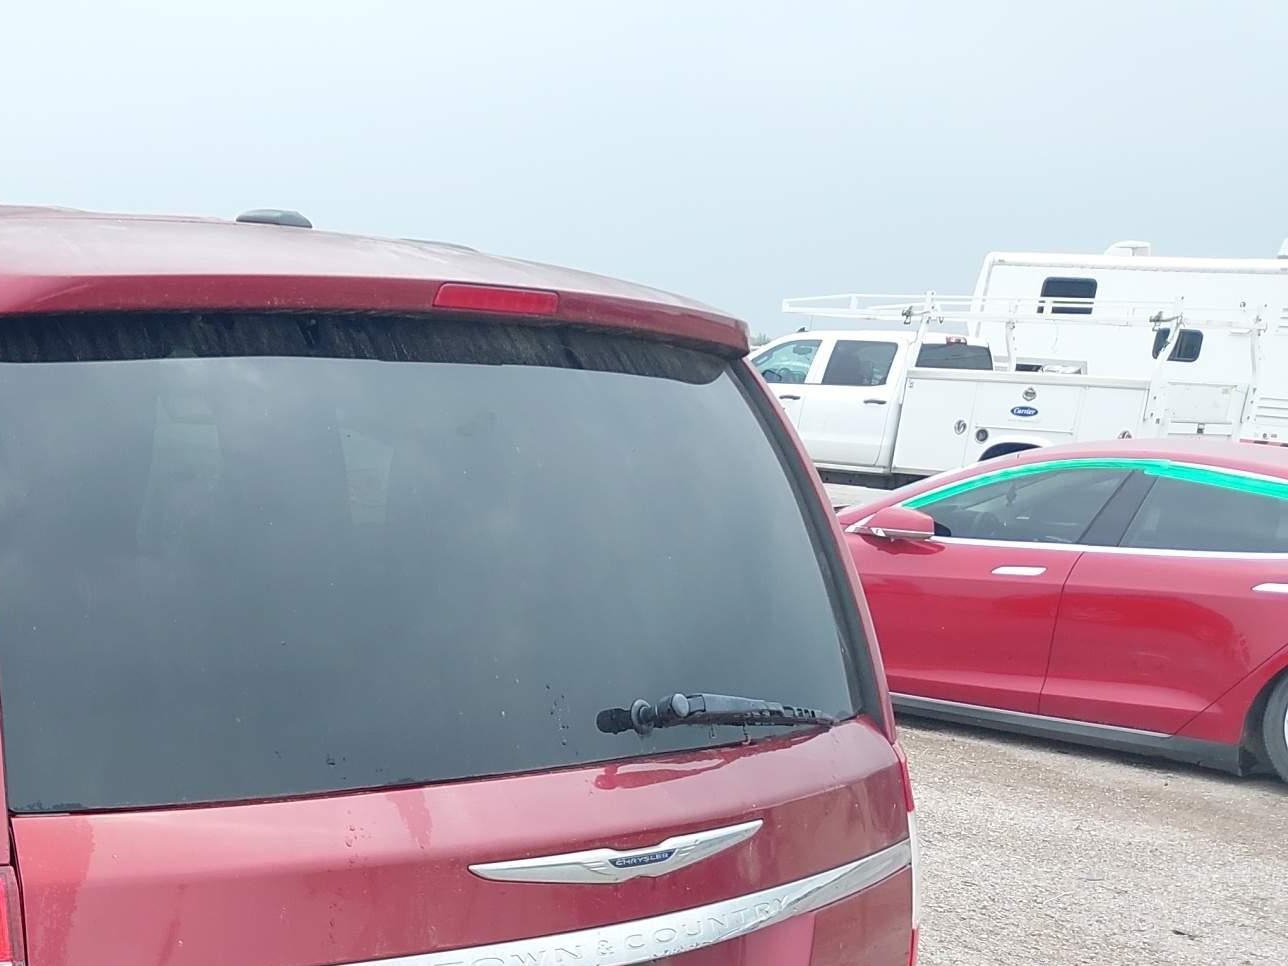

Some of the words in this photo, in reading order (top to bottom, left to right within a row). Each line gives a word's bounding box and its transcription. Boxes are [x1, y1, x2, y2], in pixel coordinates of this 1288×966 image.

[615, 852, 669, 866] CHRYSLER
[596, 936, 616, 956] &
[626, 894, 791, 949] COUNTRY
